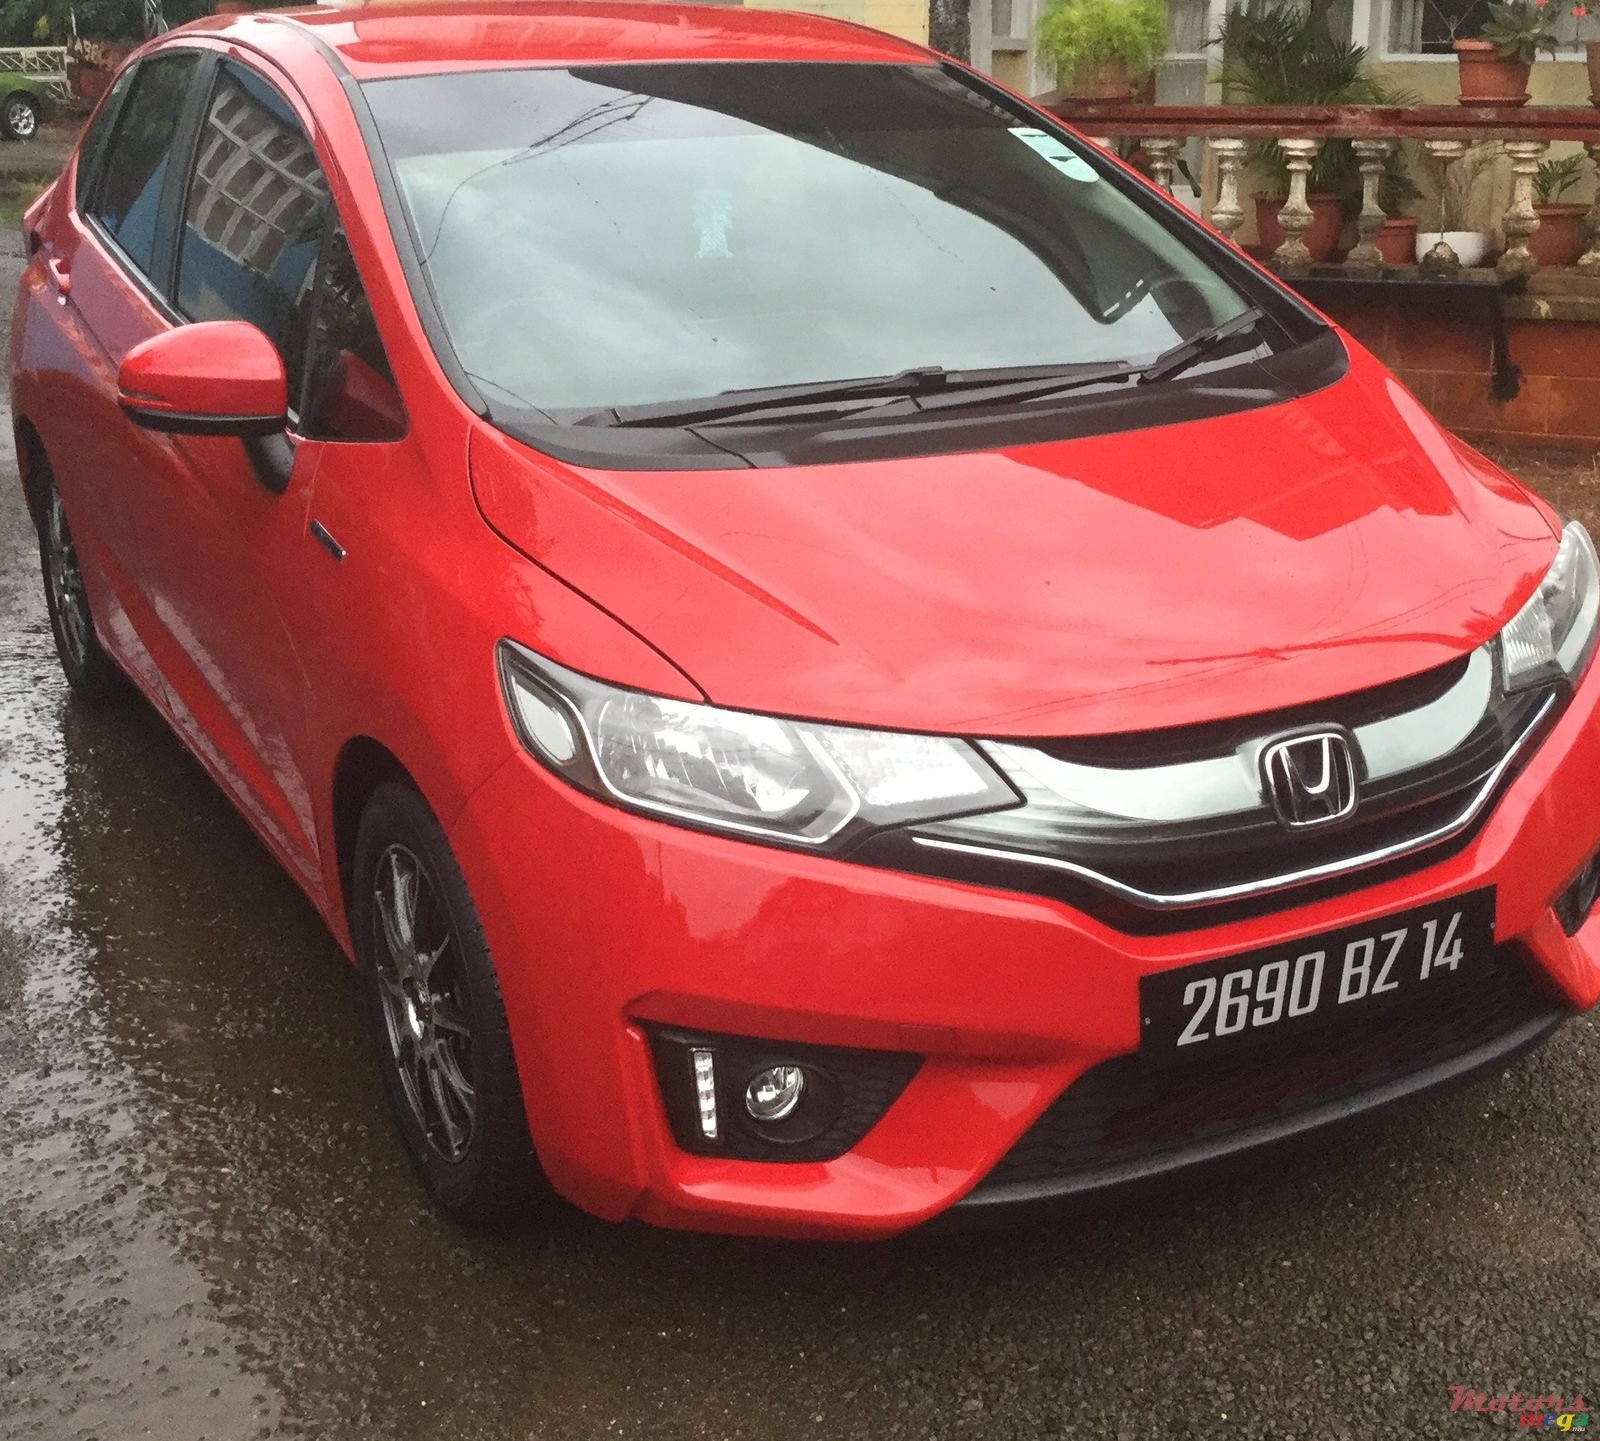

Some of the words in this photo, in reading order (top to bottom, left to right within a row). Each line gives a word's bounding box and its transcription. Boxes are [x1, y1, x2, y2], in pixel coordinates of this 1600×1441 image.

[1177, 951, 1325, 1046] 2690
[1338, 928, 1408, 1004] BZ
[1420, 912, 1464, 980] 14
